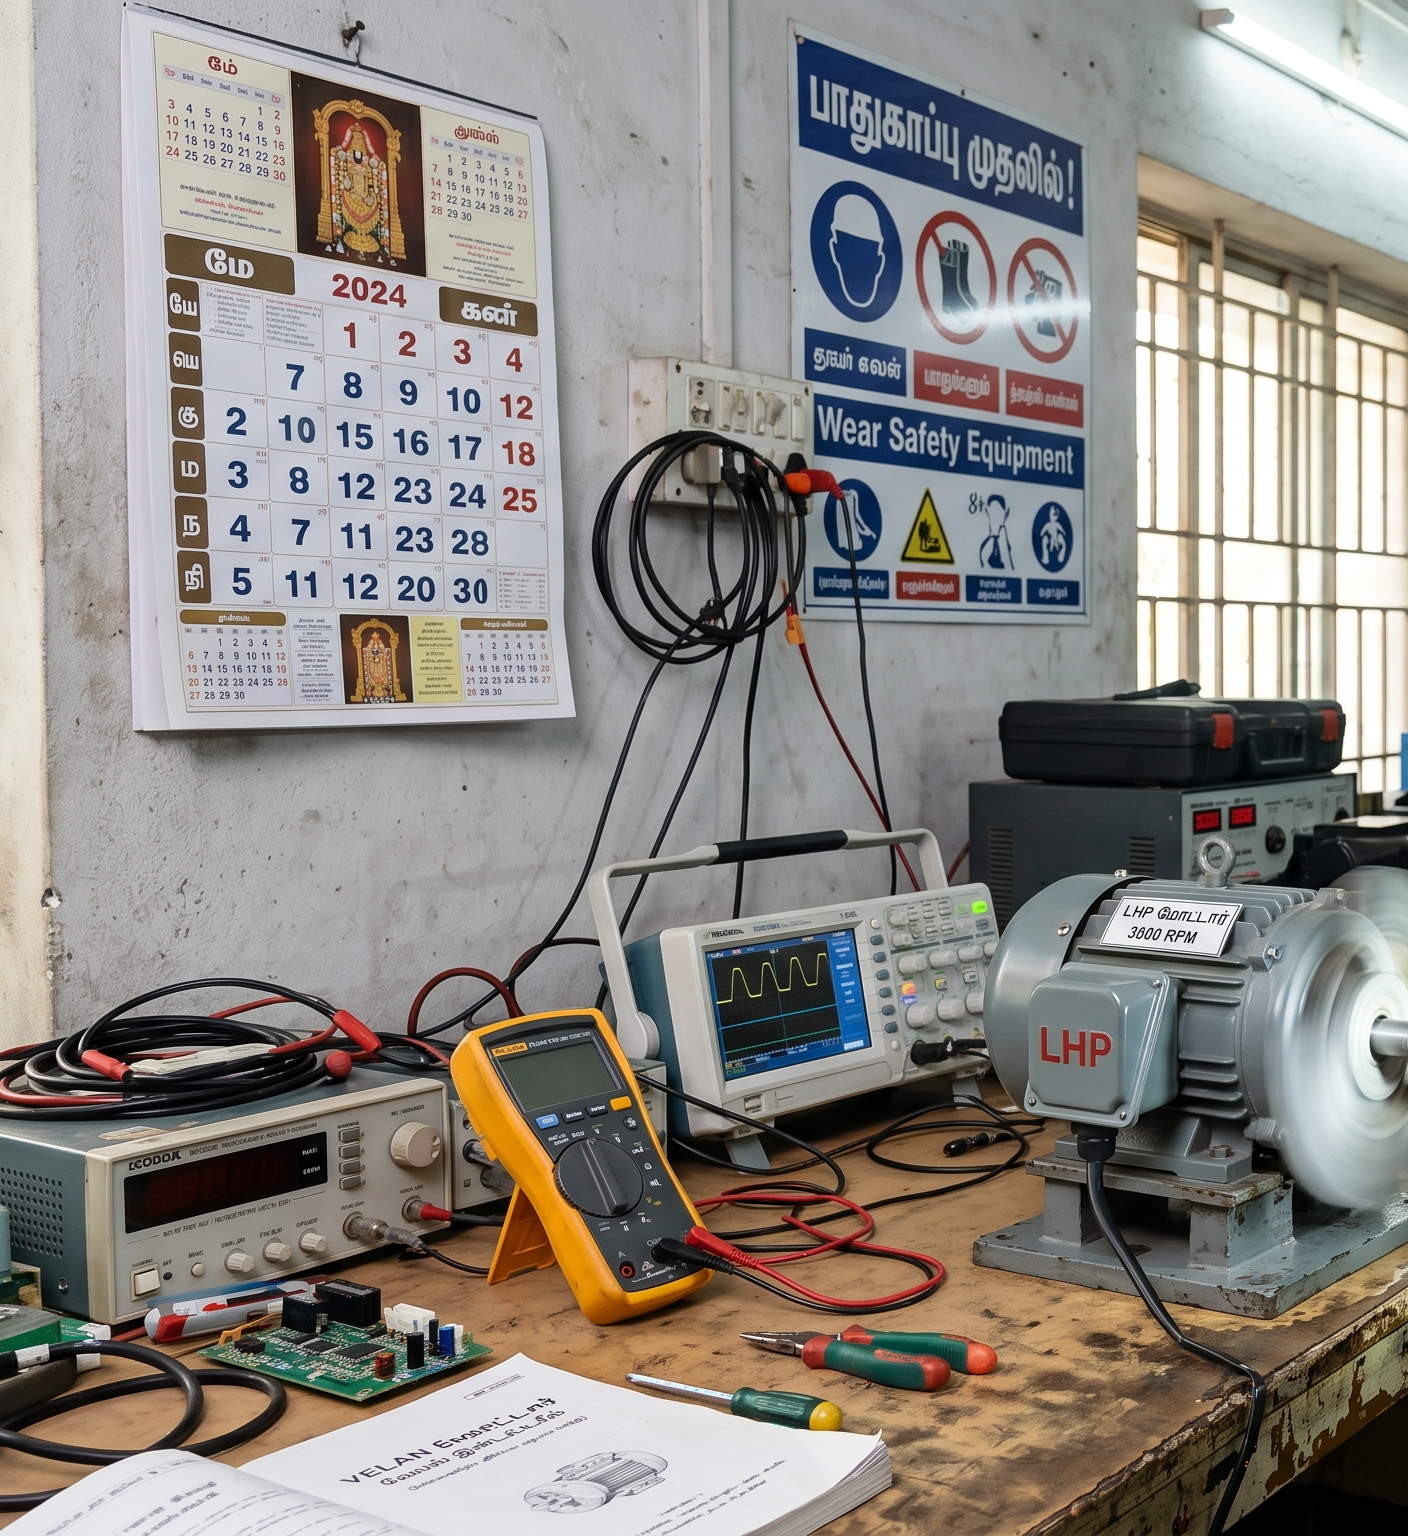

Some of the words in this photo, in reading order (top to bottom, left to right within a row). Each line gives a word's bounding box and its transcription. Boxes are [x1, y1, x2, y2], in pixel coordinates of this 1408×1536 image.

[168, 98, 175, 110] 3
[185, 103, 193, 114] 4
[204, 107, 211, 118] 5
[222, 112, 229, 123] 6
[239, 116, 247, 127] 7
[257, 120, 264, 131] 8
[274, 125, 281, 135] 9
[257, 106, 262, 116] 1
[274, 109, 280, 120] 2
[809, 74, 959, 181] பாதுகாப்பு
[165, 114, 179, 126] 10
[184, 118, 196, 130] 11
[202, 122, 215, 135] 12
[220, 127, 233, 139] 13
[238, 131, 251, 143] 14
[255, 135, 268, 147] 15
[273, 139, 285, 151] 16
[166, 130, 179, 142] 17
[184, 134, 198, 146] 18
[202, 138, 216, 150] 19
[220, 142, 234, 154] 20
[238, 146, 250, 158] 21
[255, 150, 269, 163] 22
[272, 154, 286, 166] 23
[166, 145, 180, 158] 24
[184, 149, 198, 162] 25
[203, 153, 217, 166] 26
[220, 157, 234, 169] 27
[238, 161, 252, 174] 28
[256, 166, 270, 178] 29
[273, 169, 286, 182] 30
[204, 247, 254, 280] மே
[332, 273, 407, 309] 2024
[343, 321, 357, 349] 1
[398, 330, 417, 358] 2
[453, 338, 472, 365] 3
[505, 347, 523, 373] 4
[285, 363, 305, 391] 7
[343, 371, 363, 399] 8
[399, 379, 418, 406] 9
[446, 386, 481, 415] 10
[499, 393, 533, 421] 12
[226, 406, 247, 437] 2
[278, 414, 316, 444] 10
[336, 421, 374, 451] 15
[393, 428, 429, 457] 16
[447, 434, 482, 461] 17
[501, 440, 536, 467] 18
[817, 405, 882, 448] Wear
[889, 416, 961, 467] Safety
[967, 429, 1075, 475] Equipment
[227, 460, 249, 489] 3
[289, 466, 310, 495] 8
[337, 472, 375, 501] 12
[393, 476, 433, 505] 23
[449, 481, 487, 509] 24
[502, 486, 538, 513] 25
[229, 514, 252, 543] 4
[291, 518, 311, 546] 7
[340, 522, 372, 550] 11
[395, 525, 434, 554] 23
[451, 528, 489, 557] 28
[232, 567, 252, 596] 5
[285, 569, 318, 599] 11
[342, 572, 379, 601] 12
[397, 575, 436, 603] 20
[453, 577, 488, 605] 30
[1123, 905, 1154, 918] LHP
[1163, 929, 1199, 944] RPM
[1039, 1026, 1113, 1068] LHP
[339, 1448, 433, 1485] VELAN
